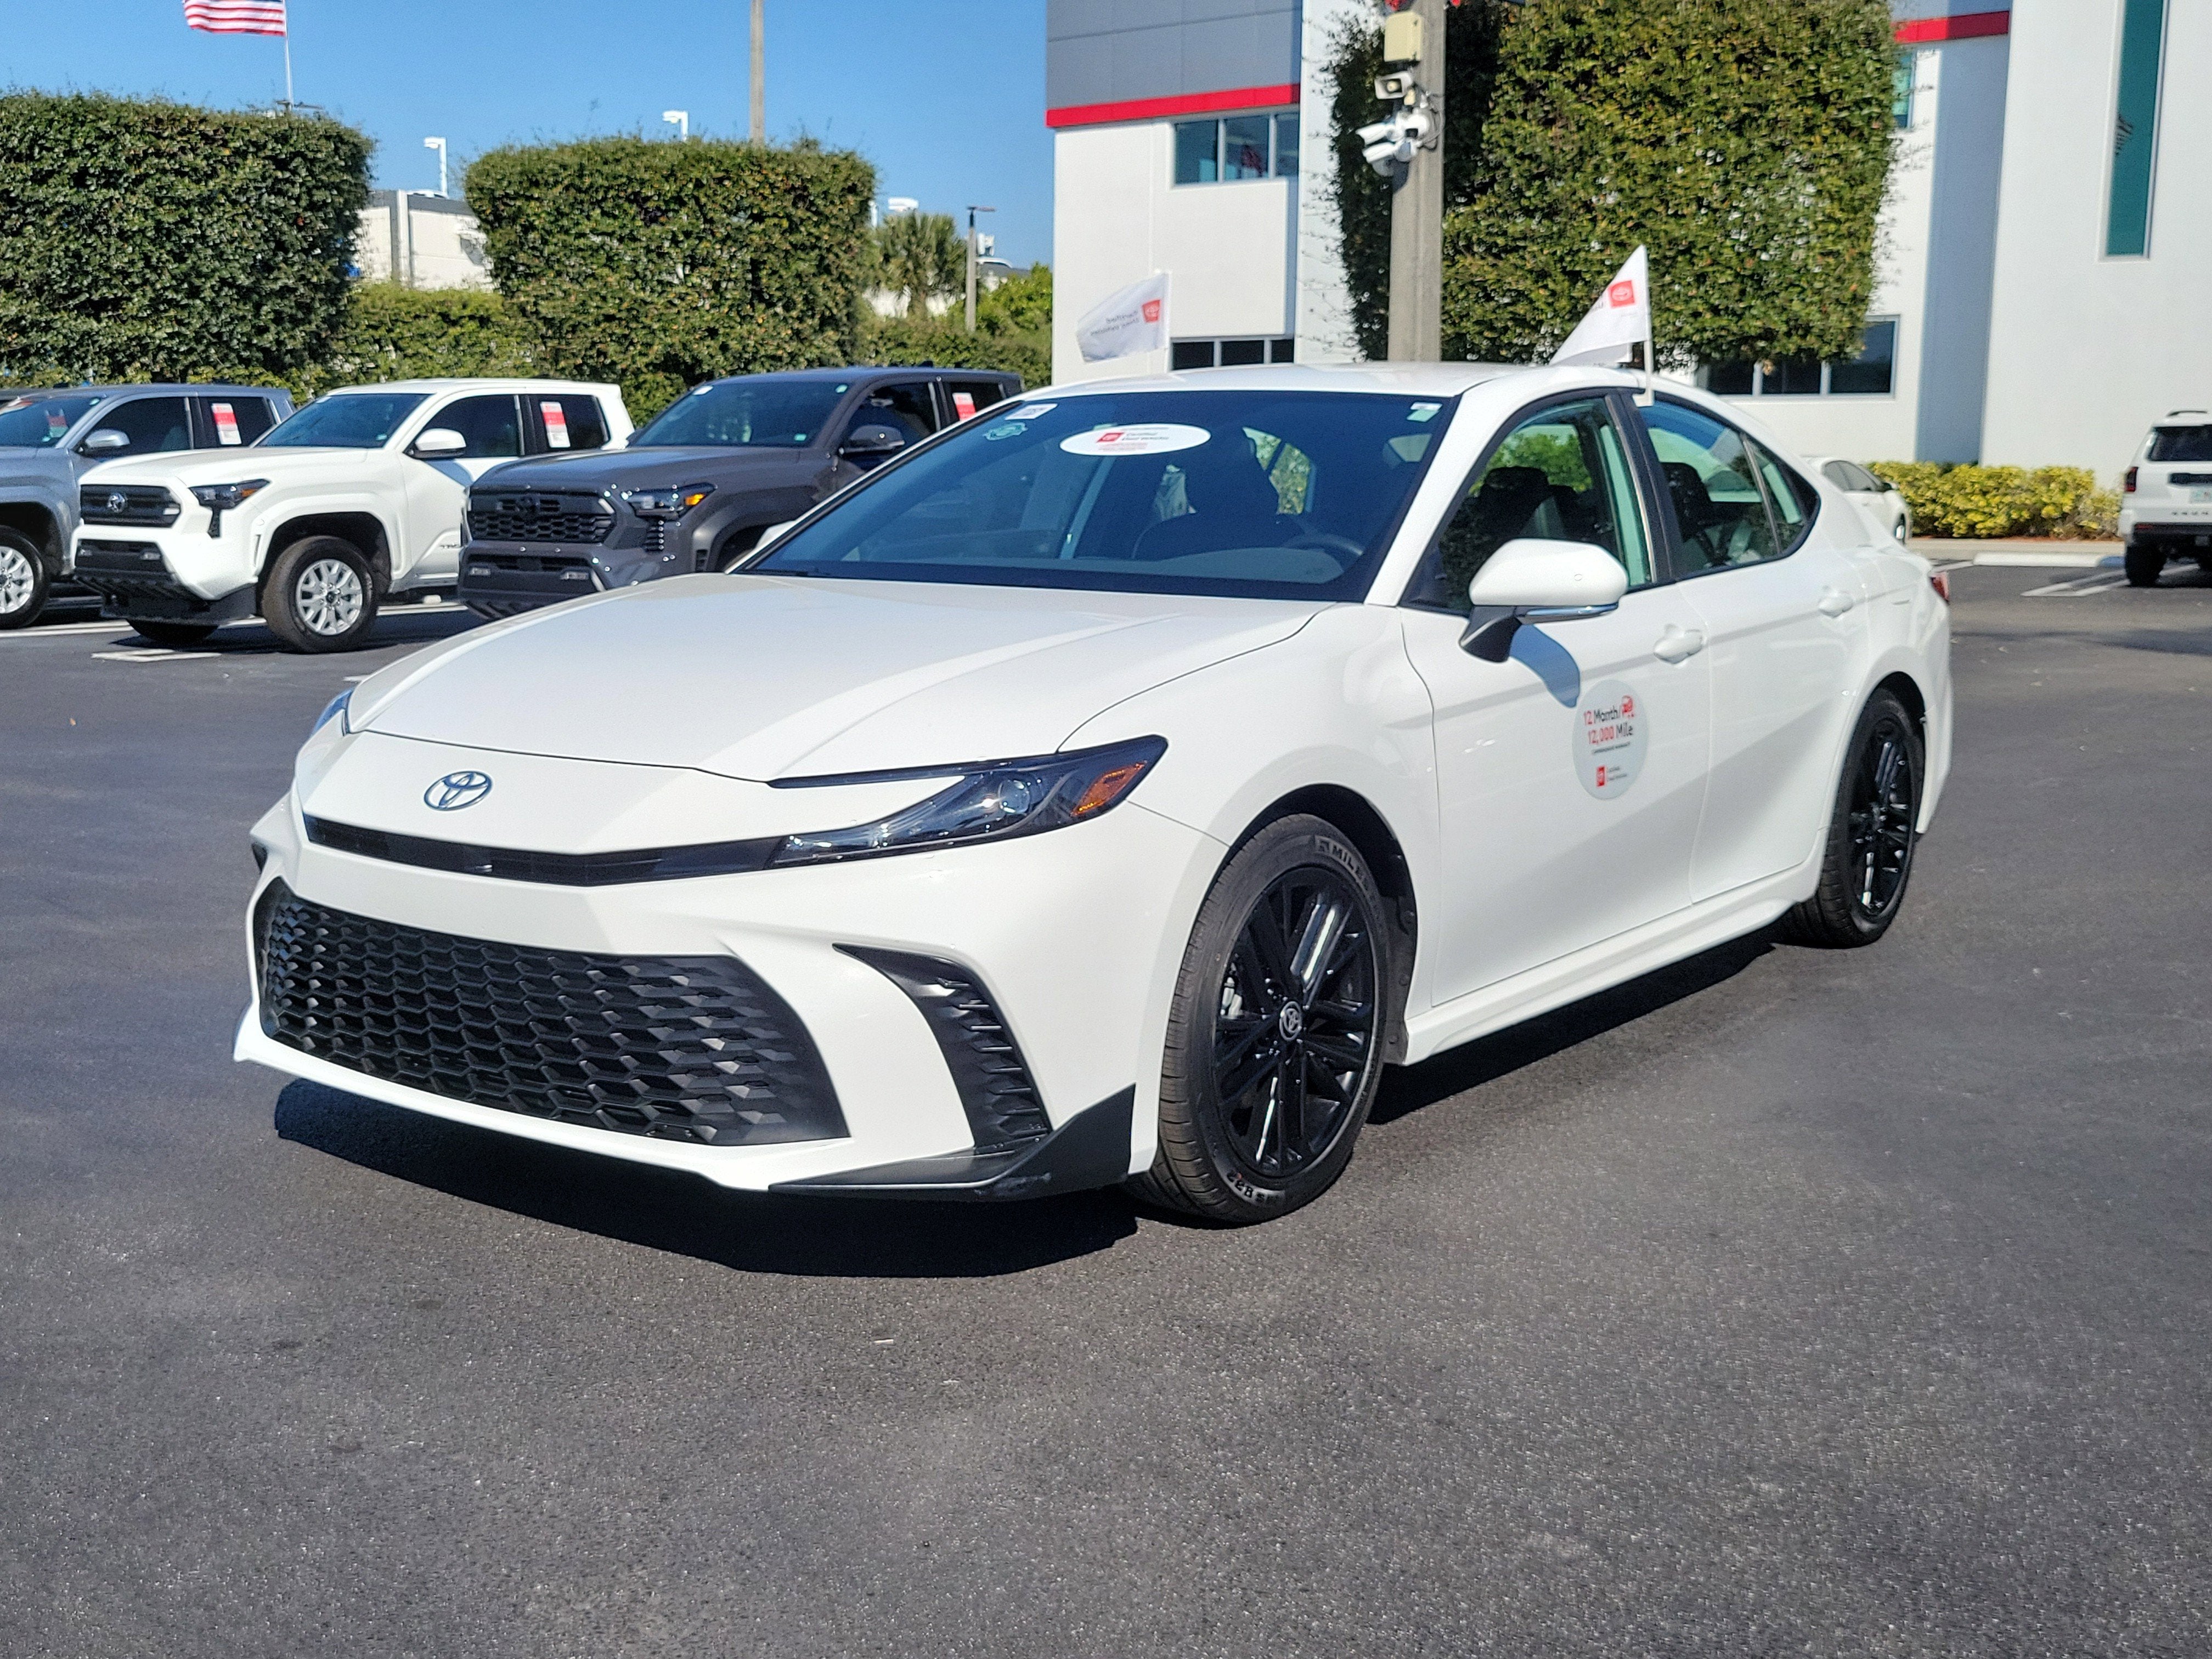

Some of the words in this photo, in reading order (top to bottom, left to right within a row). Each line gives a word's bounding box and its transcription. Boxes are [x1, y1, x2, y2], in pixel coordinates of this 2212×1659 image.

[1584, 710, 1593, 725] 12
[1588, 726, 1615, 744] 12,000
[1616, 722, 1633, 738] Mile
